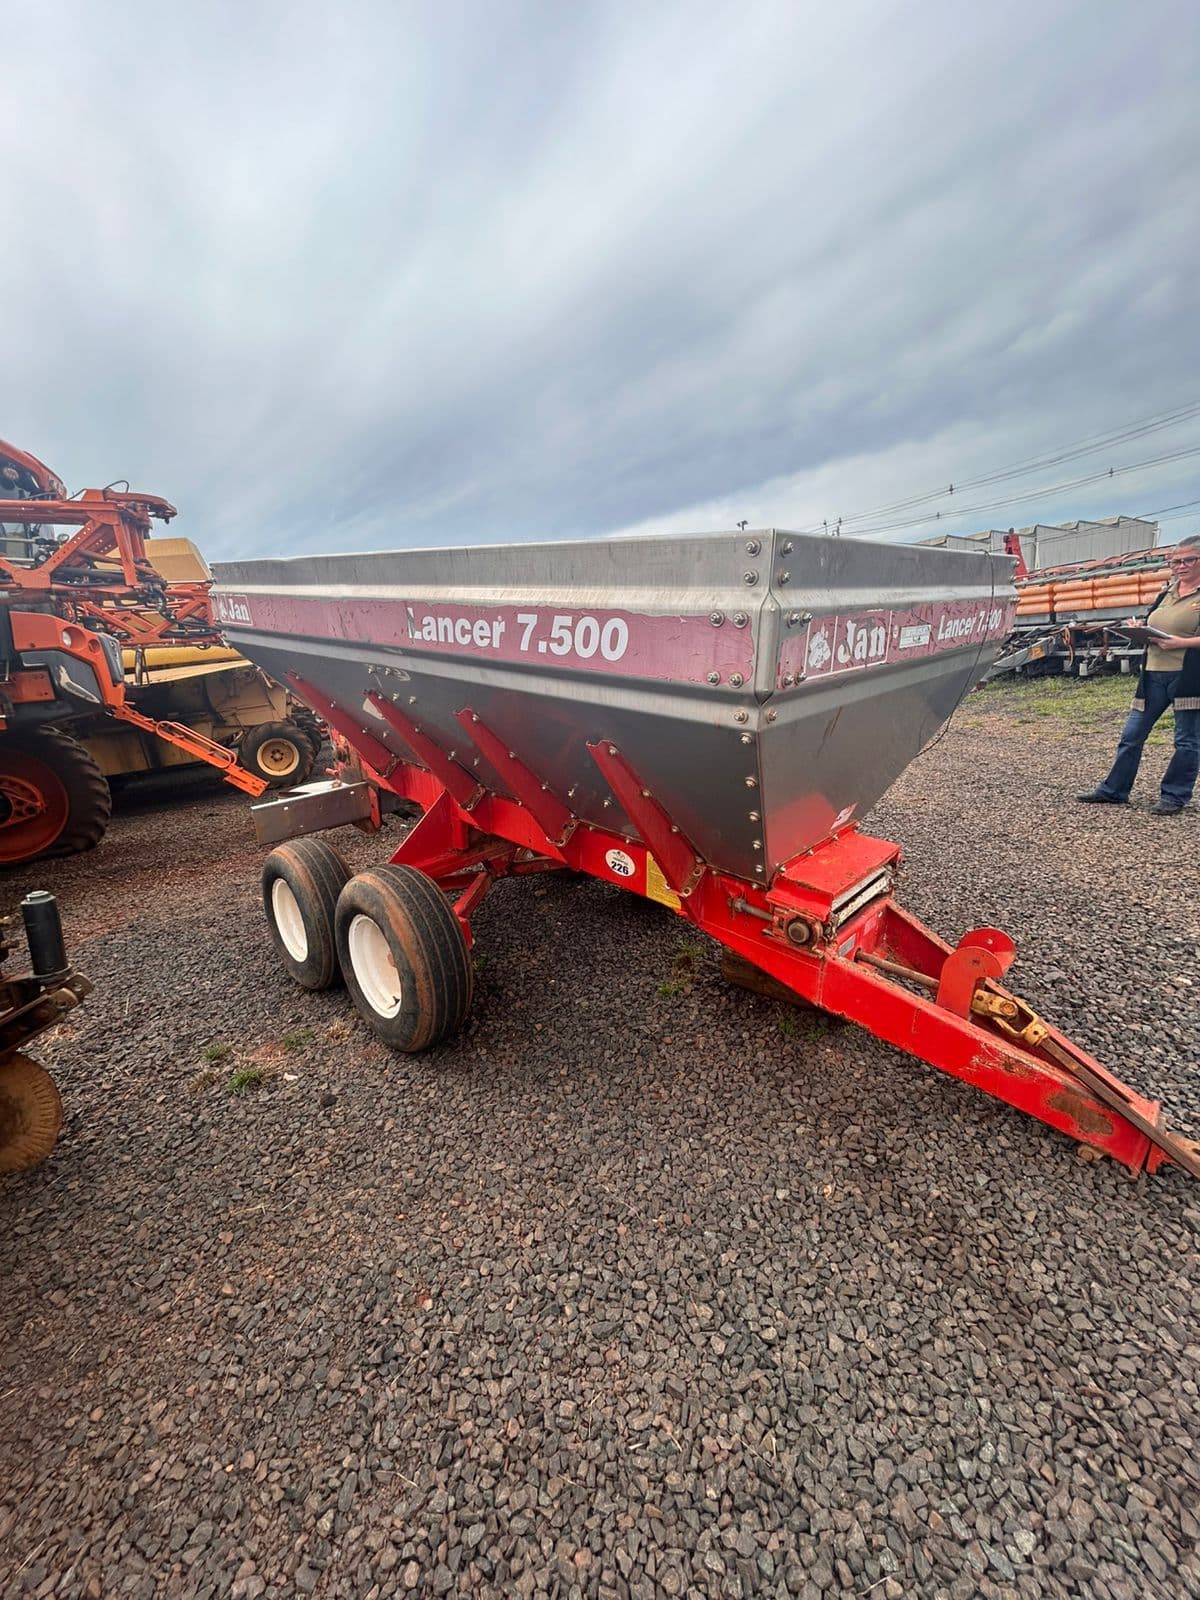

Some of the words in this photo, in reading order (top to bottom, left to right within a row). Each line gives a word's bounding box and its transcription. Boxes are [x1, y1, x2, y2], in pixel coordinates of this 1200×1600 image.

[229, 598, 250, 621] Jan
[407, 607, 505, 649] Lancer
[516, 613, 629, 662] 7.500
[838, 619, 885, 663] Jan
[938, 614, 977, 641] Lancer
[611, 861, 629, 875] 226
